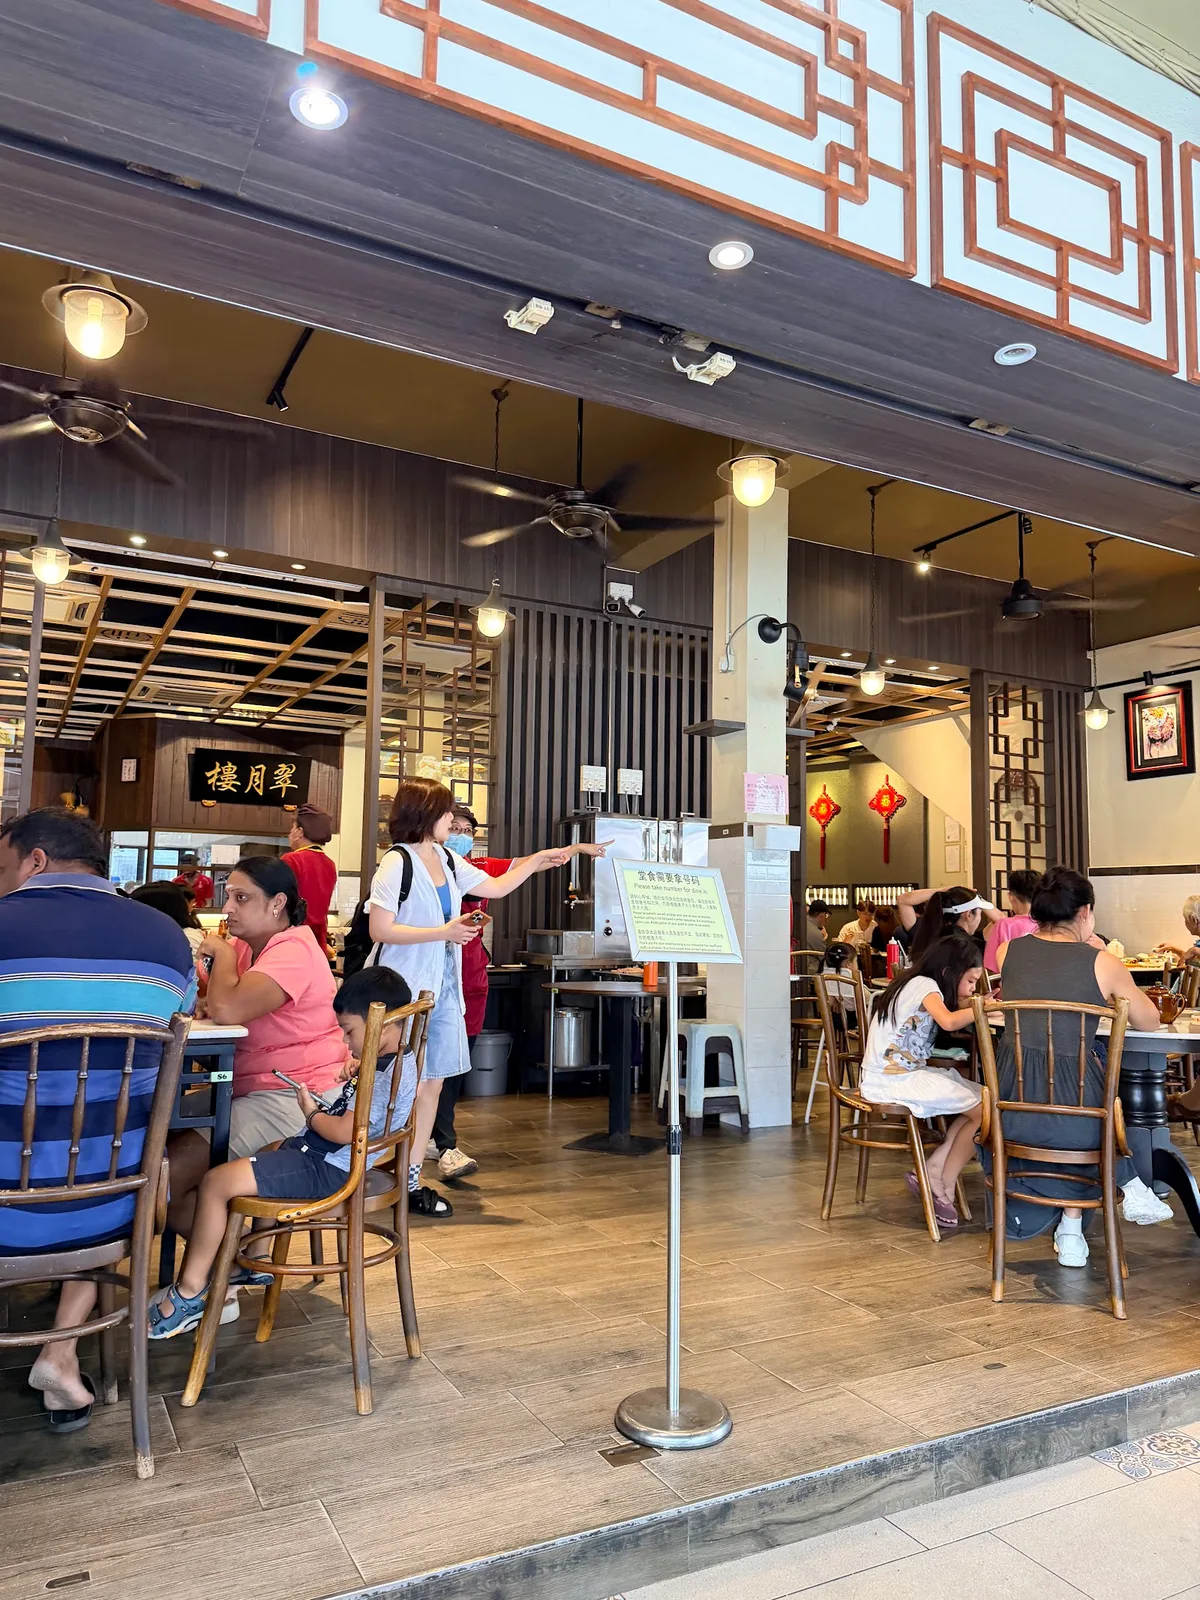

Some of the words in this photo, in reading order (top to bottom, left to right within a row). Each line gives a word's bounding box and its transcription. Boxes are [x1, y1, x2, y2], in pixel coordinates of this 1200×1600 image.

[638, 870, 700, 886] 堂食需要拿号码
